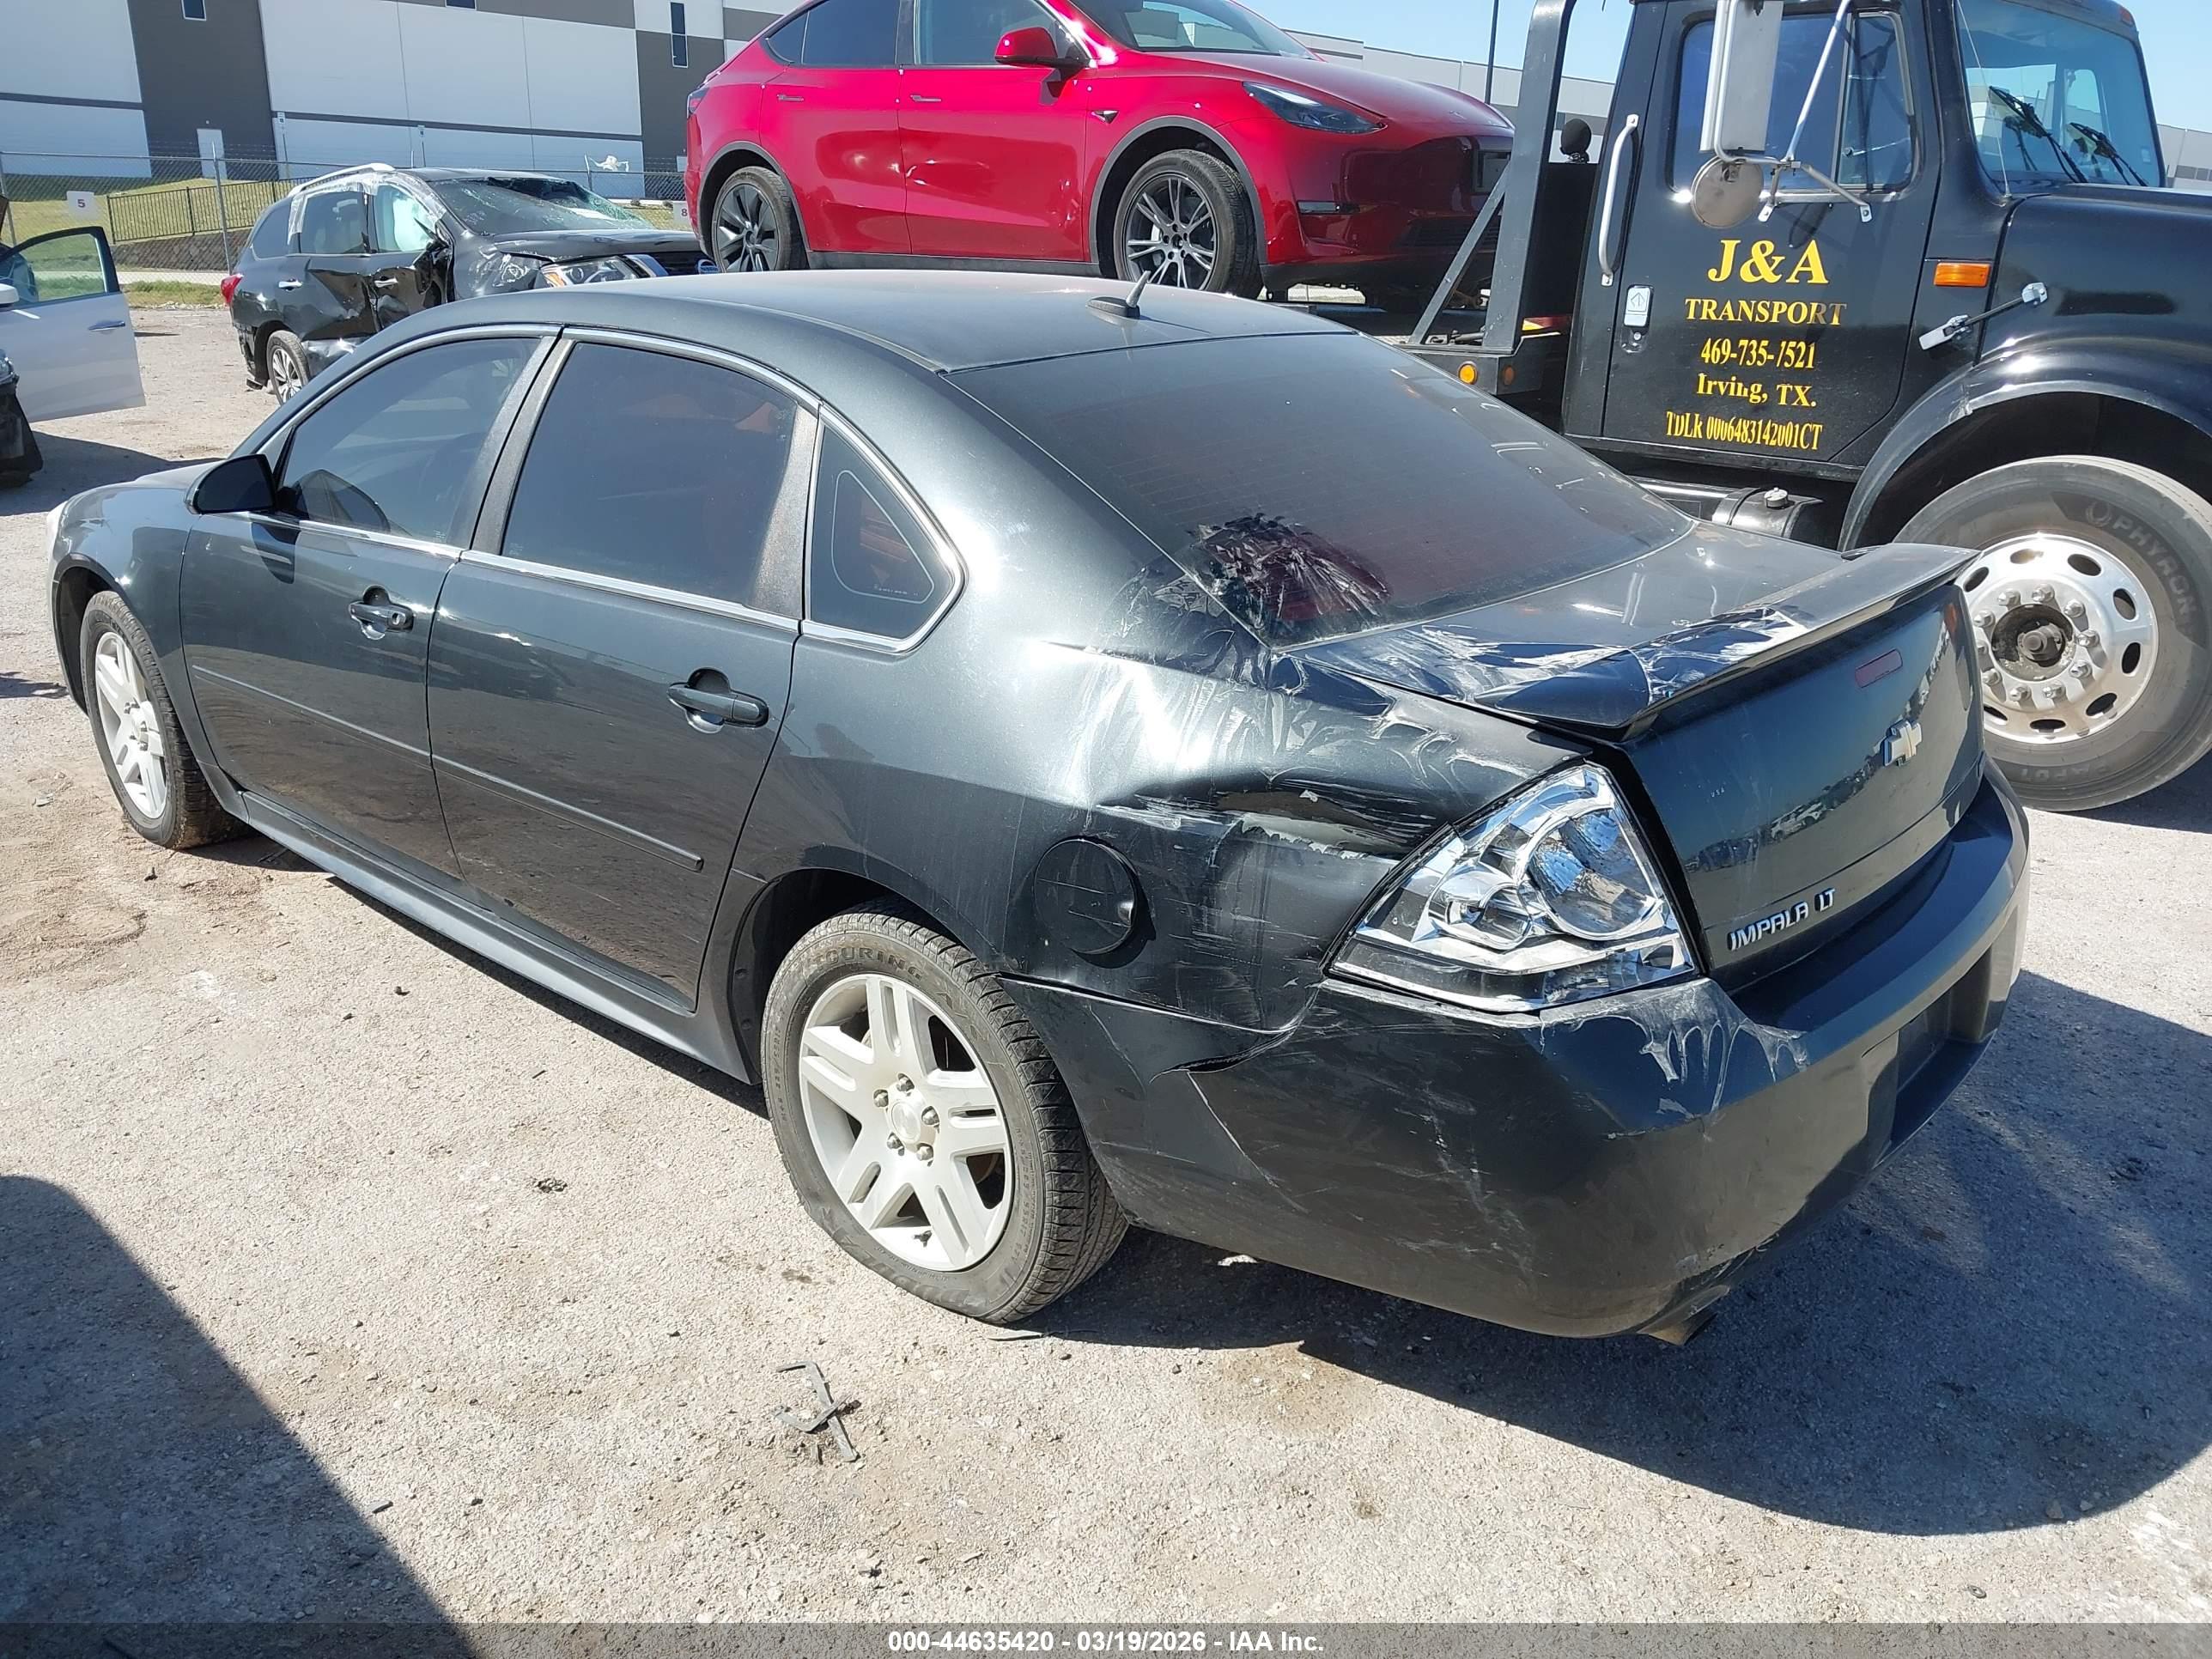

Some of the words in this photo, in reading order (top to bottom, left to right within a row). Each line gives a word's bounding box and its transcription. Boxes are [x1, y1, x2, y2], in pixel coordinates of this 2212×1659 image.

[76, 198, 86, 208] 5
[681, 208, 688, 217] 8
[1707, 239, 1829, 284] J&A
[1685, 298, 1847, 326] TRANSPORT
[1696, 373, 1768, 404] Irving,
[1776, 383, 1817, 407] TX.
[1729, 901, 1809, 952] IMPALA
[1816, 888, 1835, 912] LT
